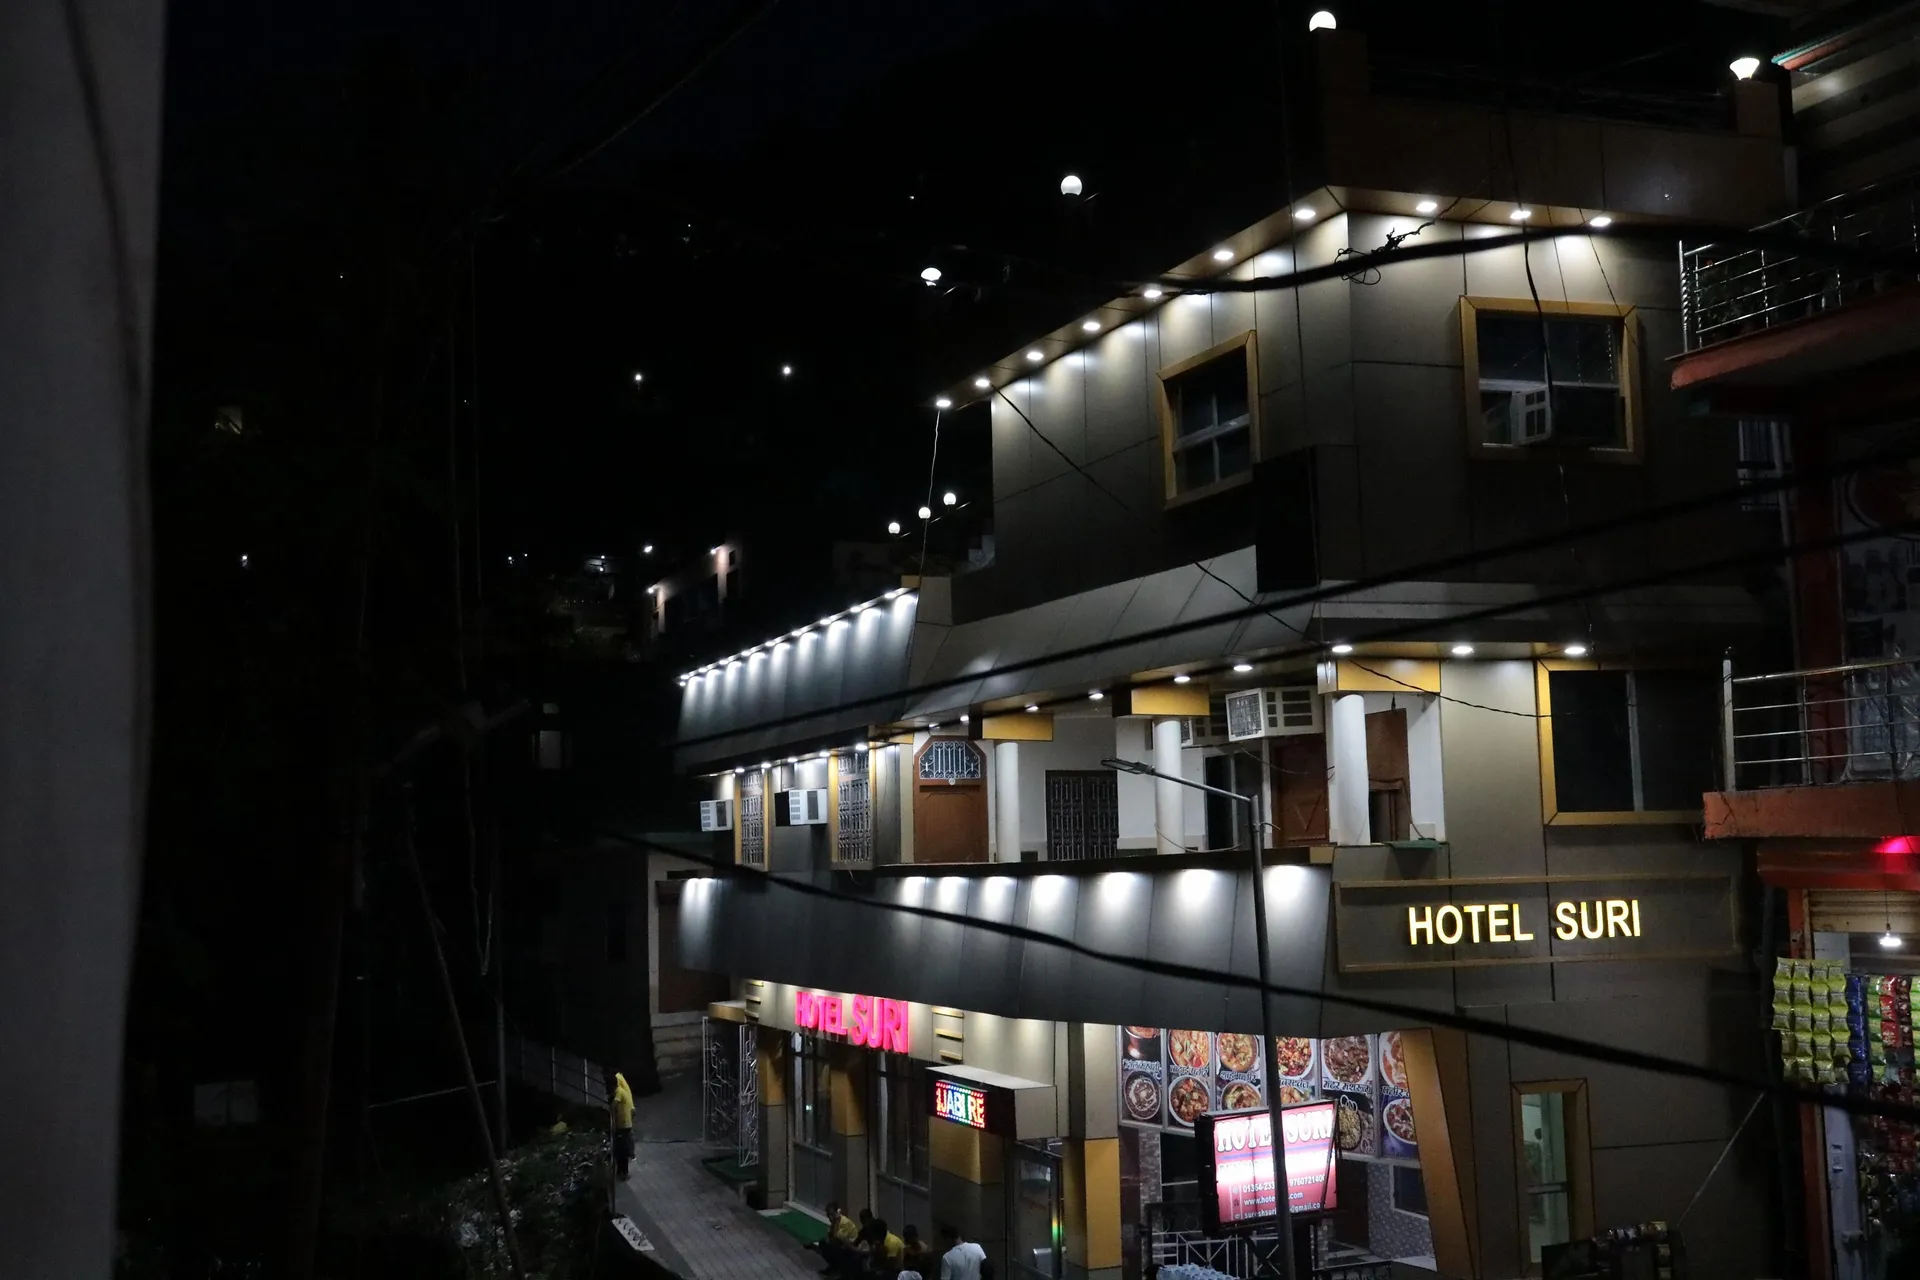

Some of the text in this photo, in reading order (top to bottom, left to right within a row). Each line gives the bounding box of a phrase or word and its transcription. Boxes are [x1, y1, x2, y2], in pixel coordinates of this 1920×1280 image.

[1408, 899, 1641, 945] HOTEL SURI
[795, 990, 909, 1054] HOTEL SURI
[1216, 1115, 1274, 1152] HOTE
